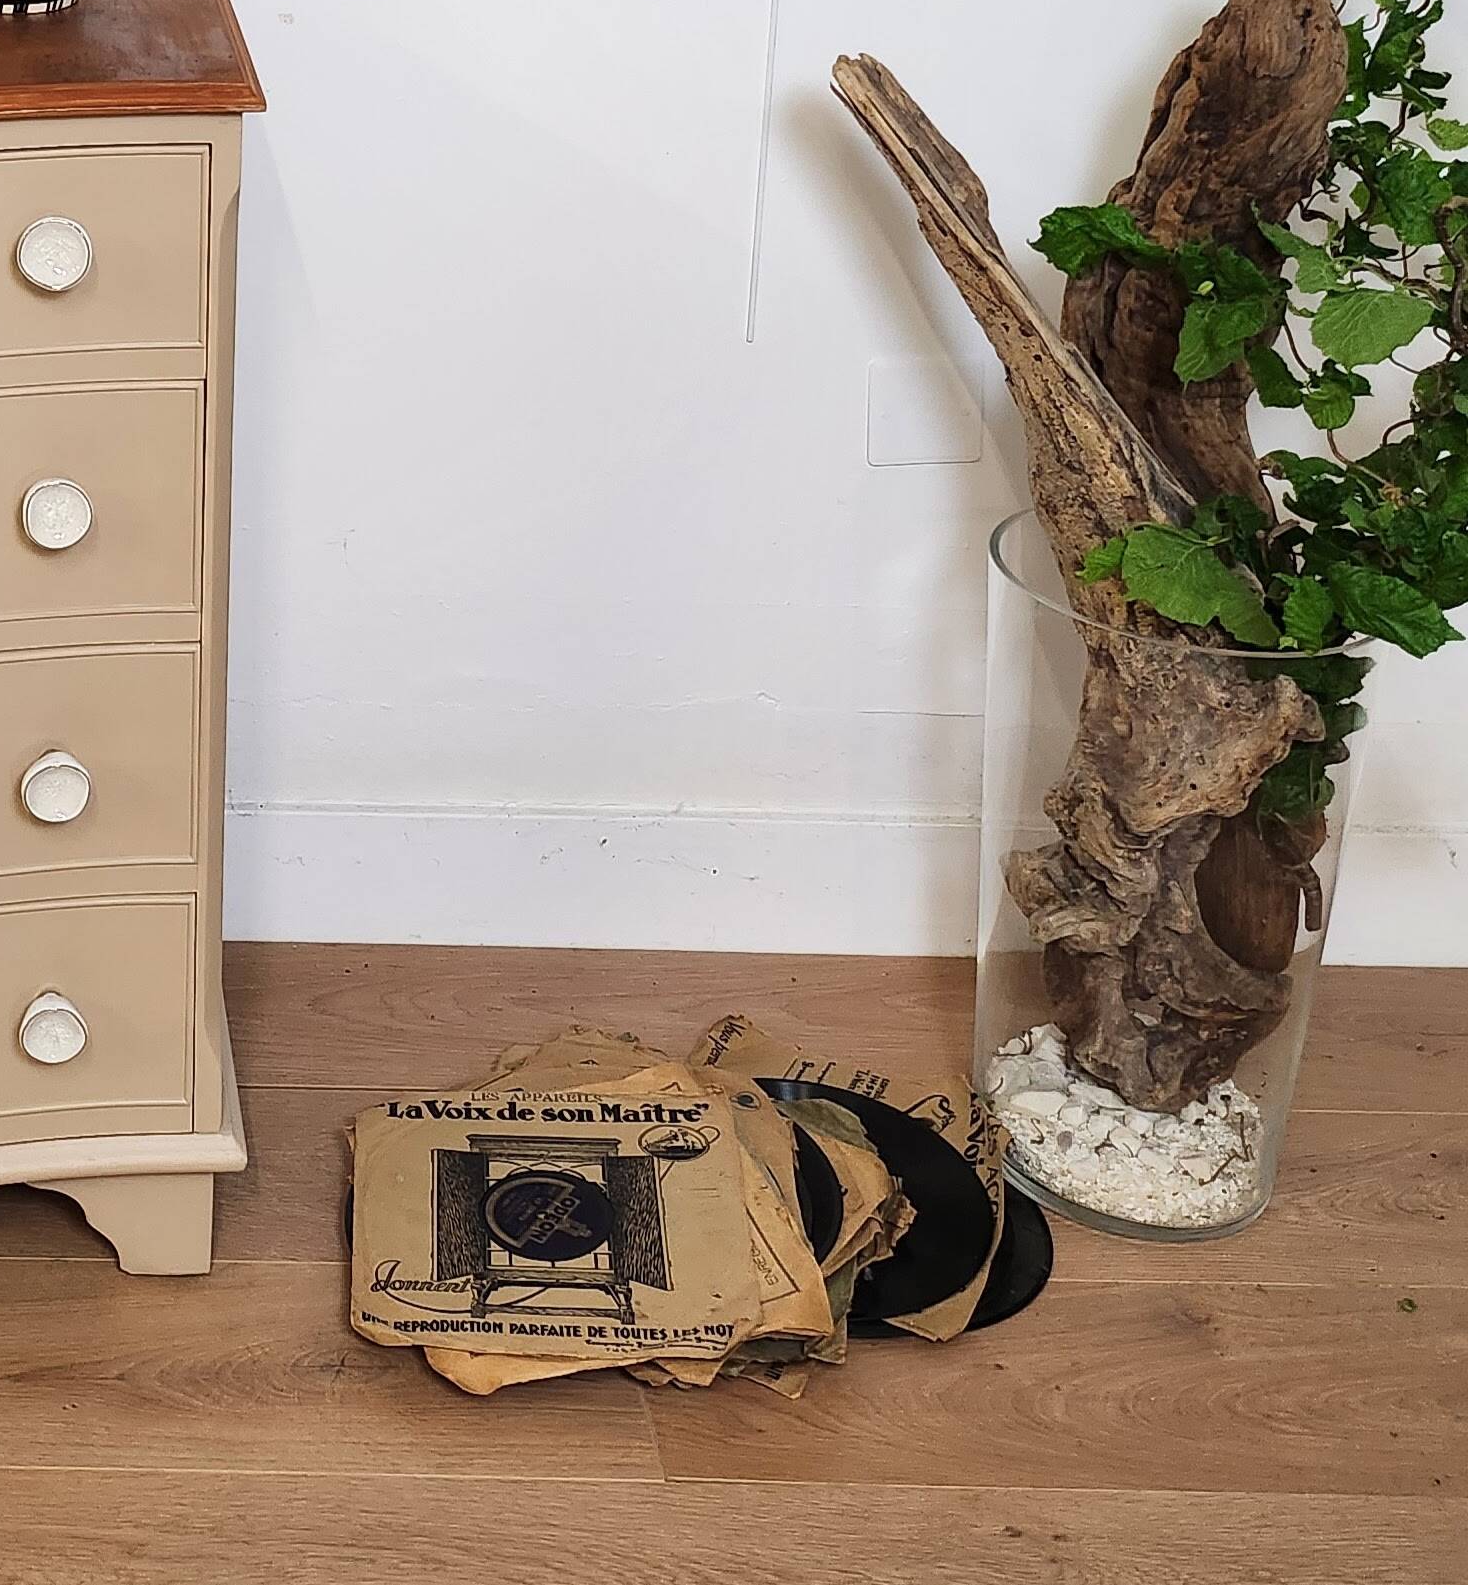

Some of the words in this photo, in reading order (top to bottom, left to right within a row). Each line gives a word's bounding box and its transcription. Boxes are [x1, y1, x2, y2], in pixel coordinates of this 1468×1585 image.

[470, 1092, 500, 1103] LES
[421, 1099, 494, 1121] Voix
[496, 1101, 536, 1122] de
[540, 1107, 596, 1123] son
[529, 1195, 579, 1244] ODEON
[393, 1319, 504, 1334] REPRODUCTION
[509, 1323, 583, 1338] PARFAITE
[587, 1325, 608, 1338] DE
[612, 1326, 669, 1341] TOUTES
